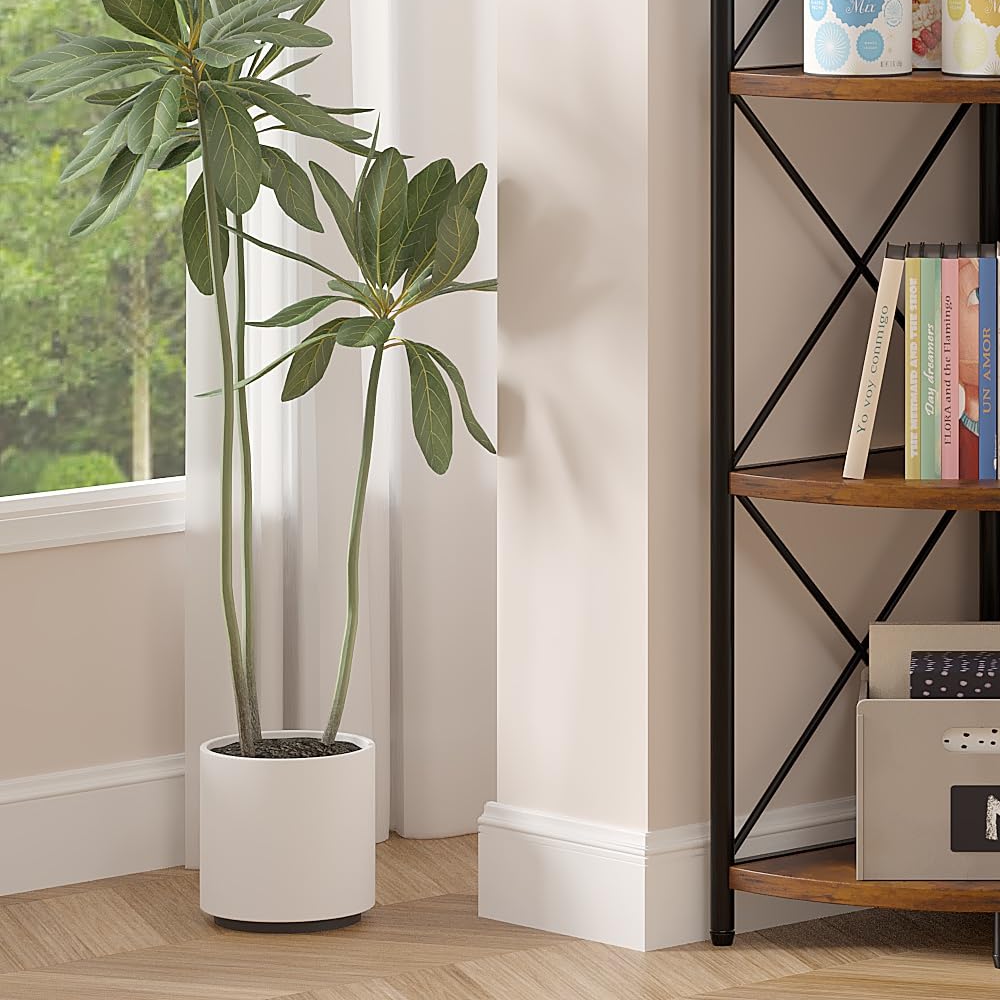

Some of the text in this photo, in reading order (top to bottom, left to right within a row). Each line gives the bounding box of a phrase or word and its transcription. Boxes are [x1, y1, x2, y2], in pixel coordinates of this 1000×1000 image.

[944, 295, 953, 353] Flamingo
[856, 305, 889, 434] Yo voy conmigo
[923, 323, 936, 416] Day dreamers
[944, 380, 952, 403] and
[983, 327, 992, 413] UN AMOR
[944, 406, 952, 445] FLORA
